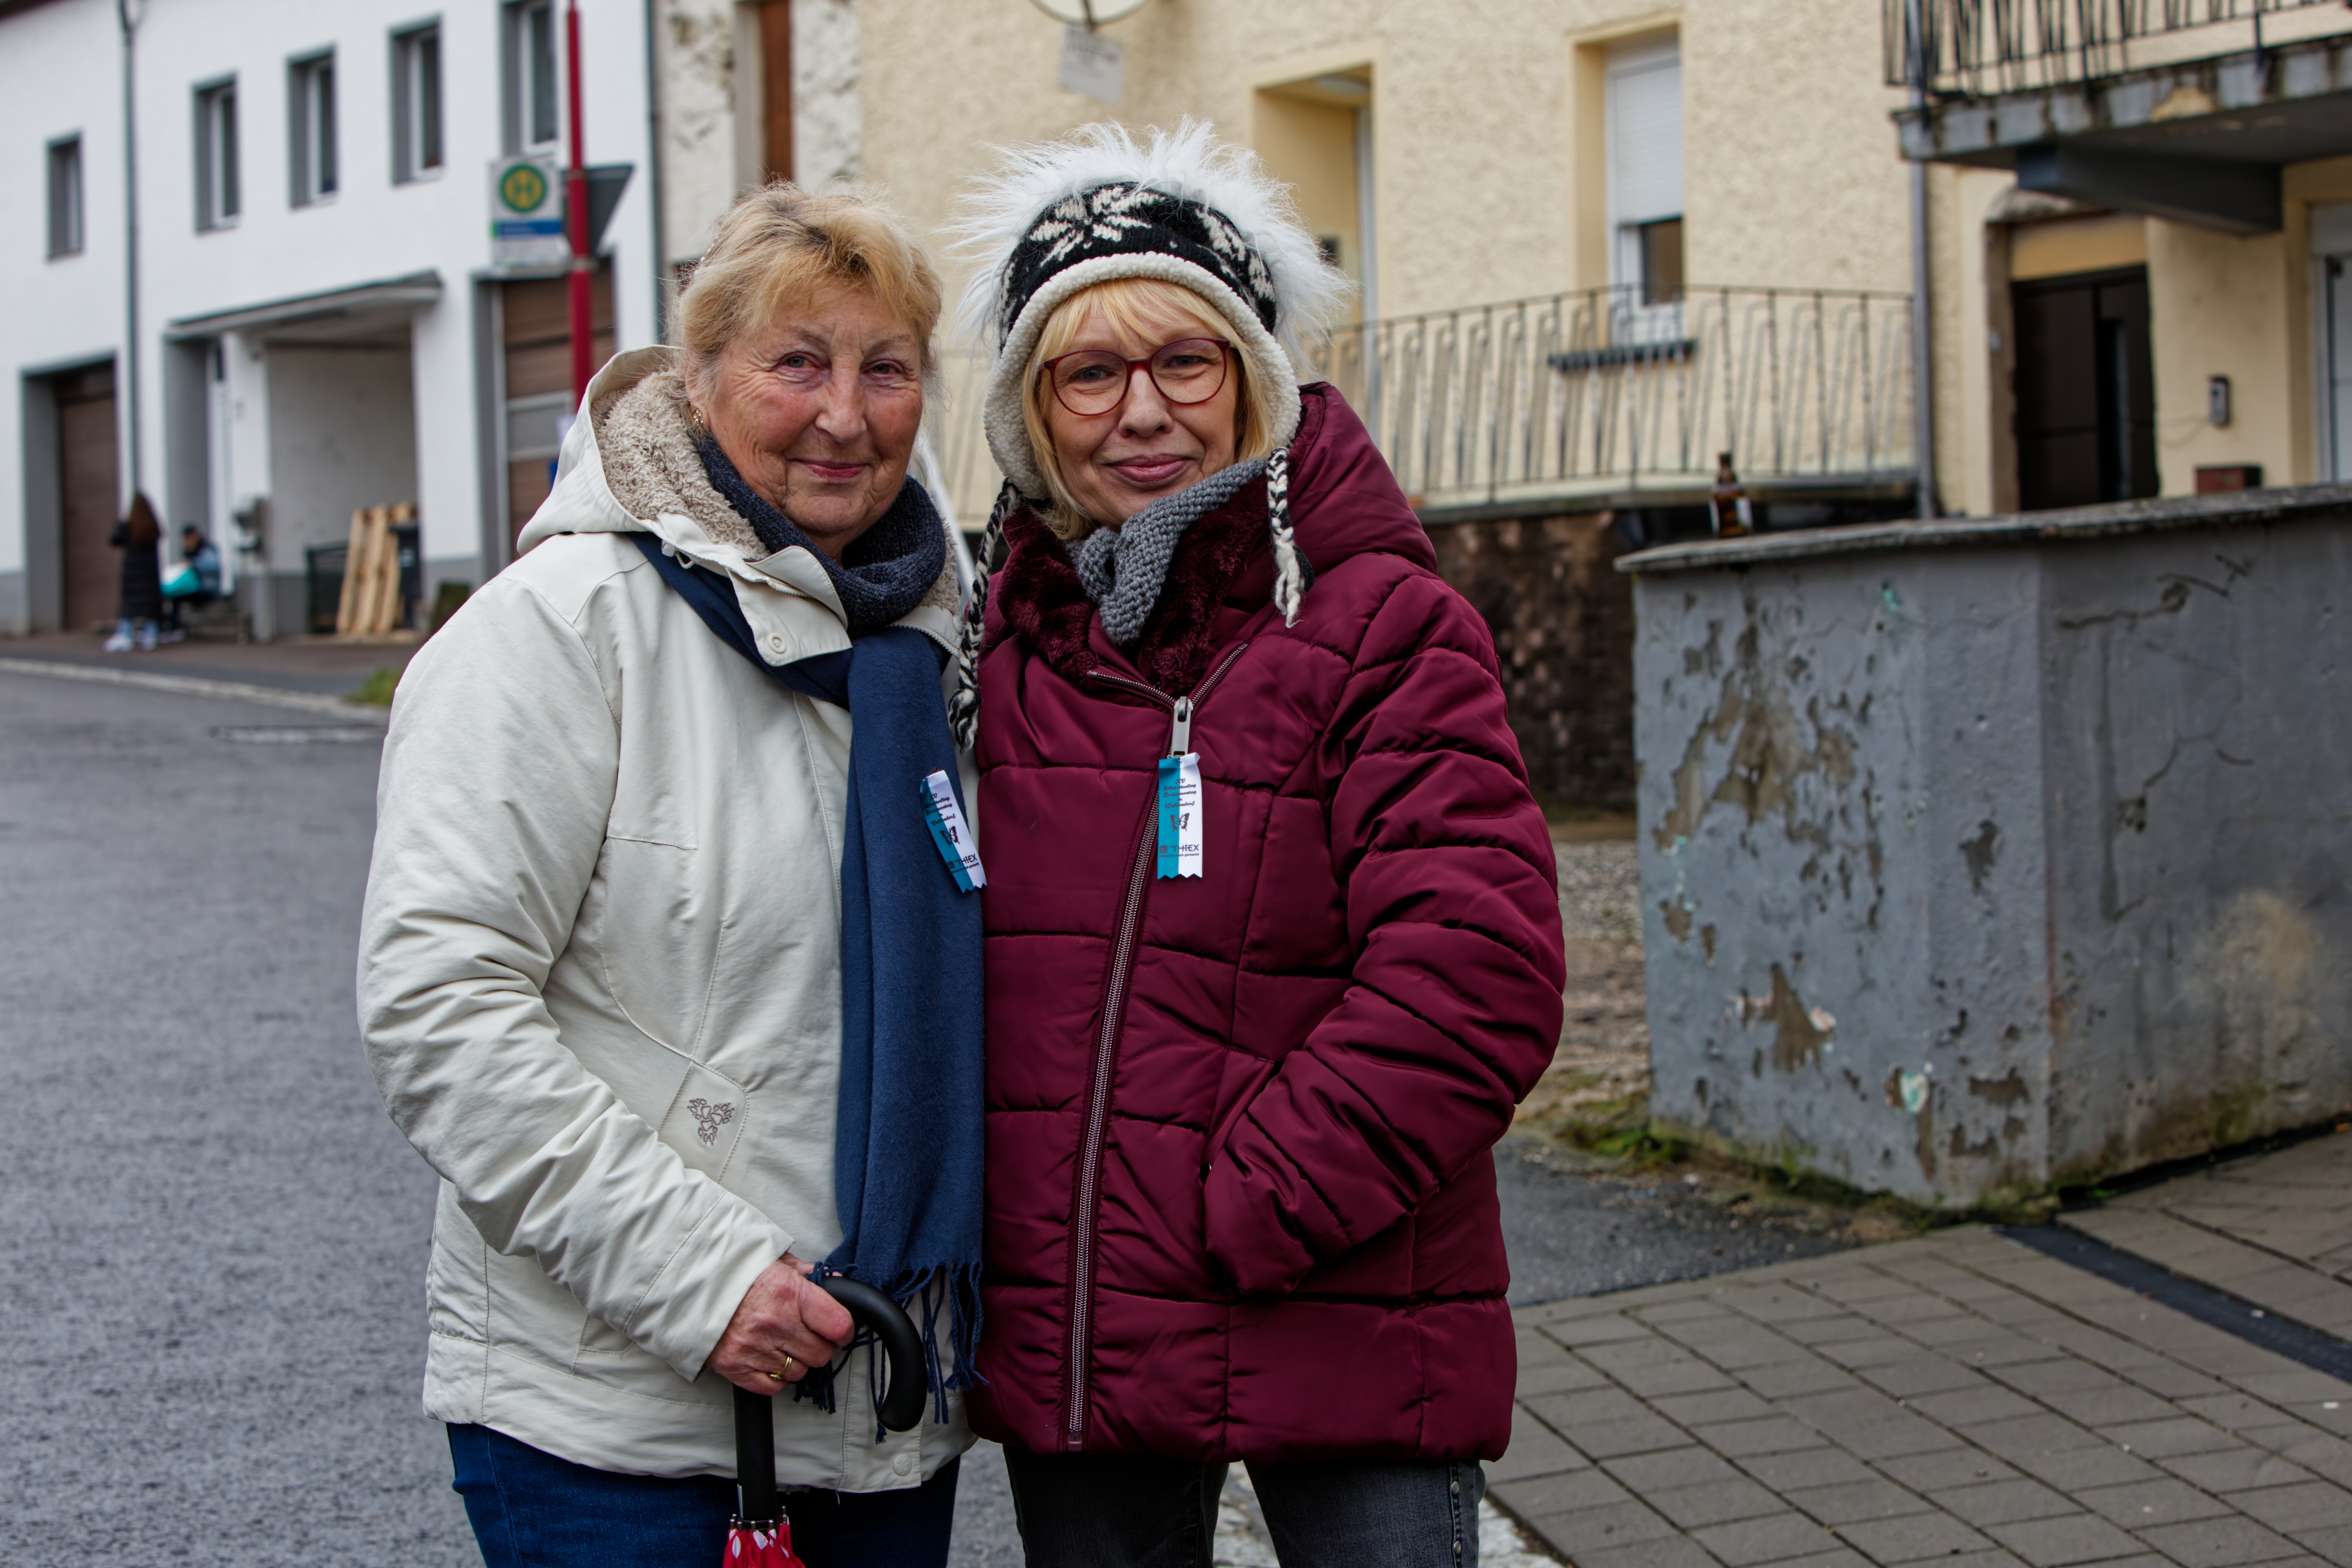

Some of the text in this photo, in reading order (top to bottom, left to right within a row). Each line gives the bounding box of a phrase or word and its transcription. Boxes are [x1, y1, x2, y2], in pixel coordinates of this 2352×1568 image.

[924, 797, 950, 809] Schmetterling
[926, 803, 953, 816] Rosenmontag
[931, 813, 956, 826] Wallendorf
